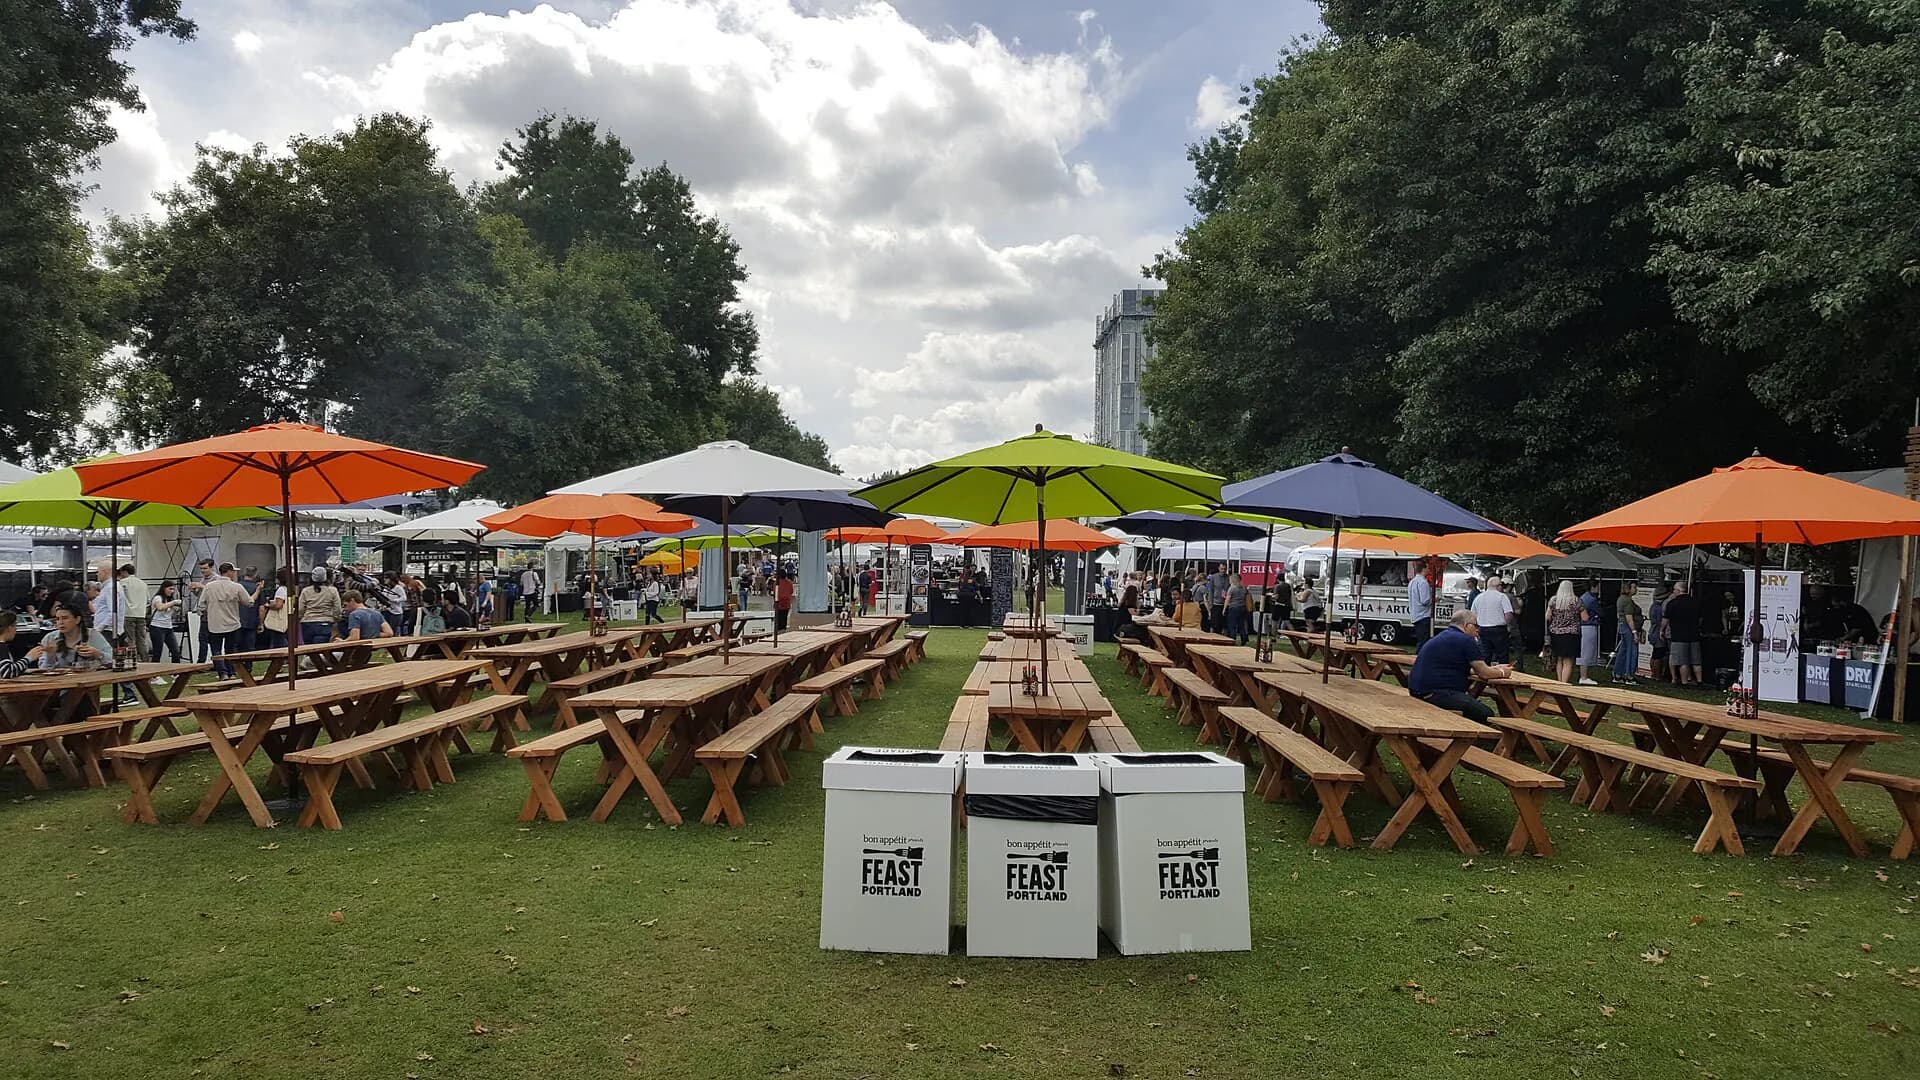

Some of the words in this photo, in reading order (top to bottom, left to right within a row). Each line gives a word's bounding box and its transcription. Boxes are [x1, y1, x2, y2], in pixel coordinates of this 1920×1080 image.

[1338, 602, 1374, 613] STELA
[863, 834, 879, 843] bon
[879, 835, 907, 845] appétit
[1007, 839, 1023, 848] bon
[1023, 840, 1052, 850] appétit
[1157, 838, 1173, 847] bon
[1173, 838, 1201, 848] appétit
[862, 858, 923, 887] FEAST
[1006, 863, 1068, 891] FEAST
[1158, 861, 1219, 890] FEAST
[862, 885, 922, 897] PORTLAND
[1006, 890, 1068, 901] PORTLAND
[1159, 888, 1221, 900] PORTLAND
